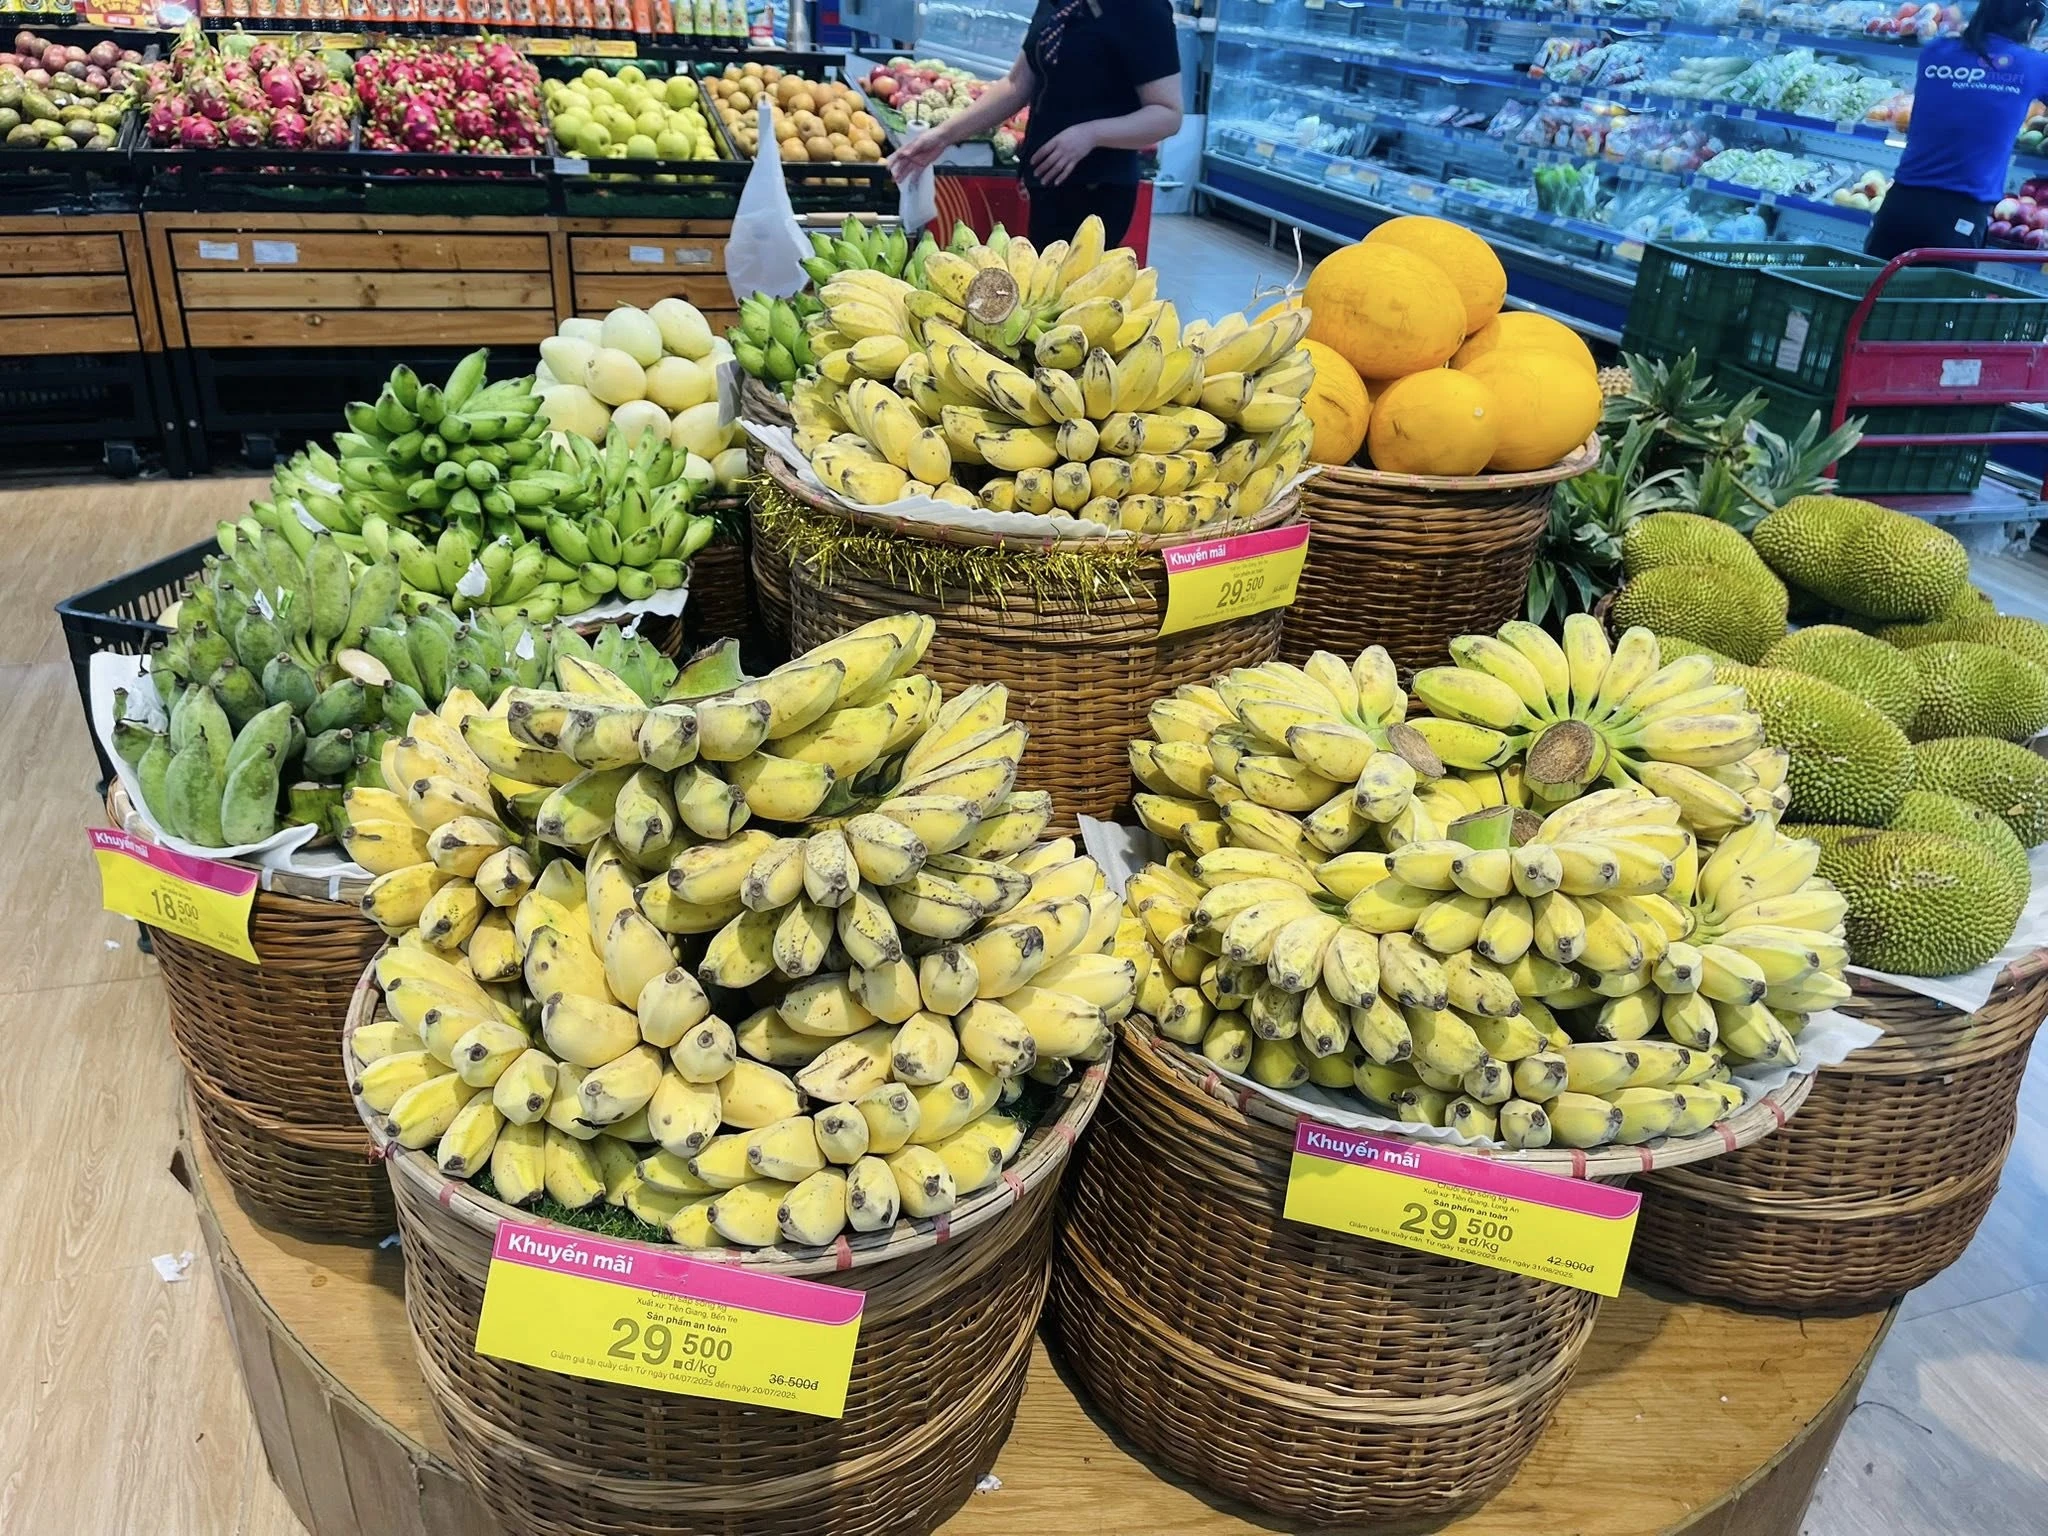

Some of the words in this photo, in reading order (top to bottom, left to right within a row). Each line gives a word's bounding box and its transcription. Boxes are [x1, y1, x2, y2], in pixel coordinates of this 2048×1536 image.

[1170, 547, 1208, 566] Khuyến
[1209, 544, 1227, 559] mãi
[1307, 1131, 1379, 1160] Khuyến
[1383, 1151, 1421, 1169] mãi
[1433, 1199, 1450, 1208] Sản
[1451, 1202, 1475, 1214] phẩm
[1476, 1208, 1488, 1216] an
[1489, 1211, 1508, 1221] toàn
[1491, 1202, 1508, 1212] Long
[508, 1233, 588, 1265] Khuyến
[592, 1254, 634, 1275] mãi
[646, 1311, 664, 1321] Sản
[665, 1315, 692, 1328] phẩm
[693, 1321, 705, 1330] an
[707, 1324, 727, 1335] toàn
[711, 1311, 726, 1321] Bến
[727, 1315, 738, 1323] Tre
[550, 1350, 572, 1361] Giảm
[572, 1354, 585, 1365] giá
[647, 1369, 668, 1381] ngày
[669, 1373, 714, 1387] 04/07/2025
[715, 1380, 730, 1389] đến
[731, 1383, 751, 1393] ngày
[769, 1373, 819, 1391] 36.500đ
